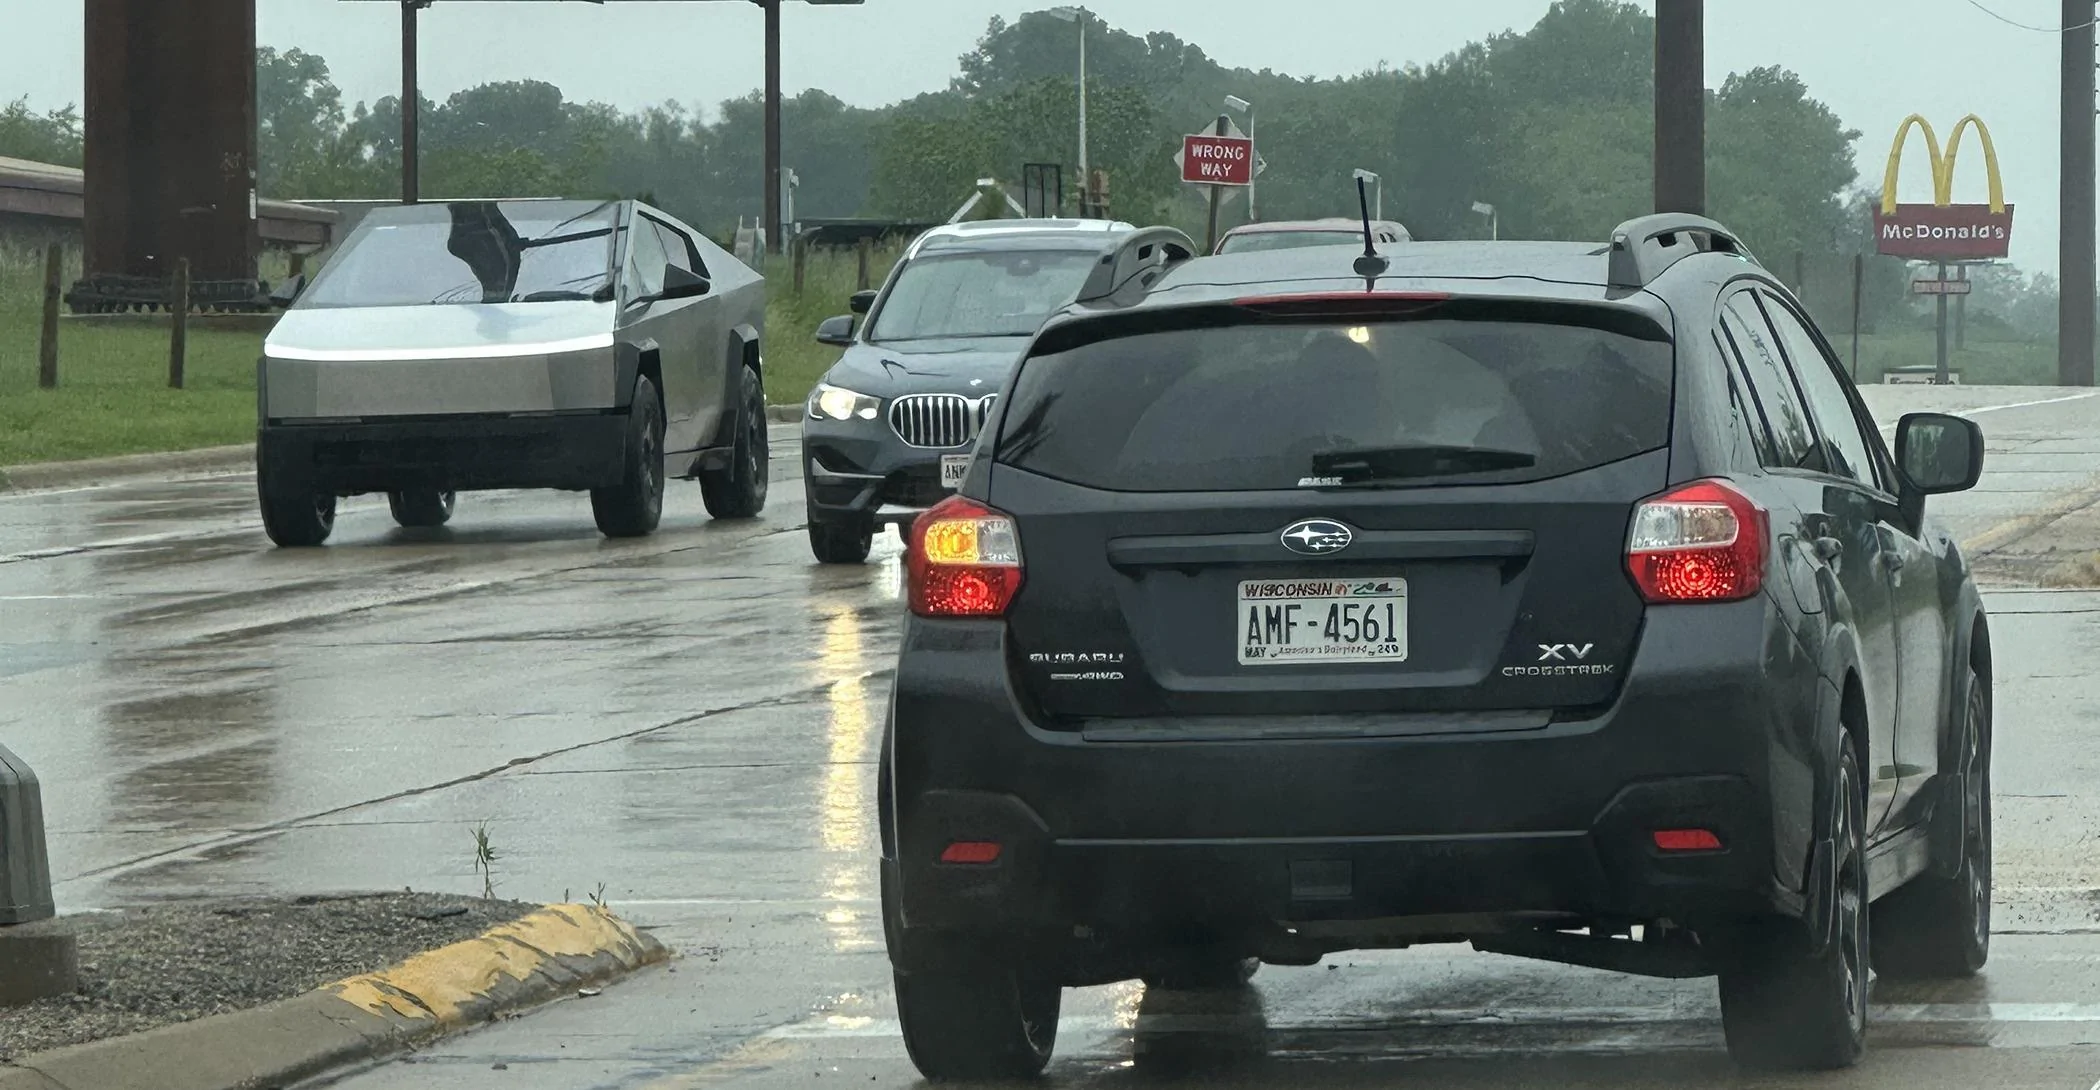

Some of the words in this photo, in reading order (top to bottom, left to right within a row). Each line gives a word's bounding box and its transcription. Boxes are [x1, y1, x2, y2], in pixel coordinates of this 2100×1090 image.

[1192, 144, 1244, 160] WRONG
[1200, 162, 1232, 177] WAY
[1882, 223, 2005, 239] McDonald's
[1245, 583, 1332, 597] WISCONSIN
[1029, 653, 1124, 663] SUBARU
[1538, 643, 1594, 660] XV
[1502, 664, 1614, 677] CROSSTREK
